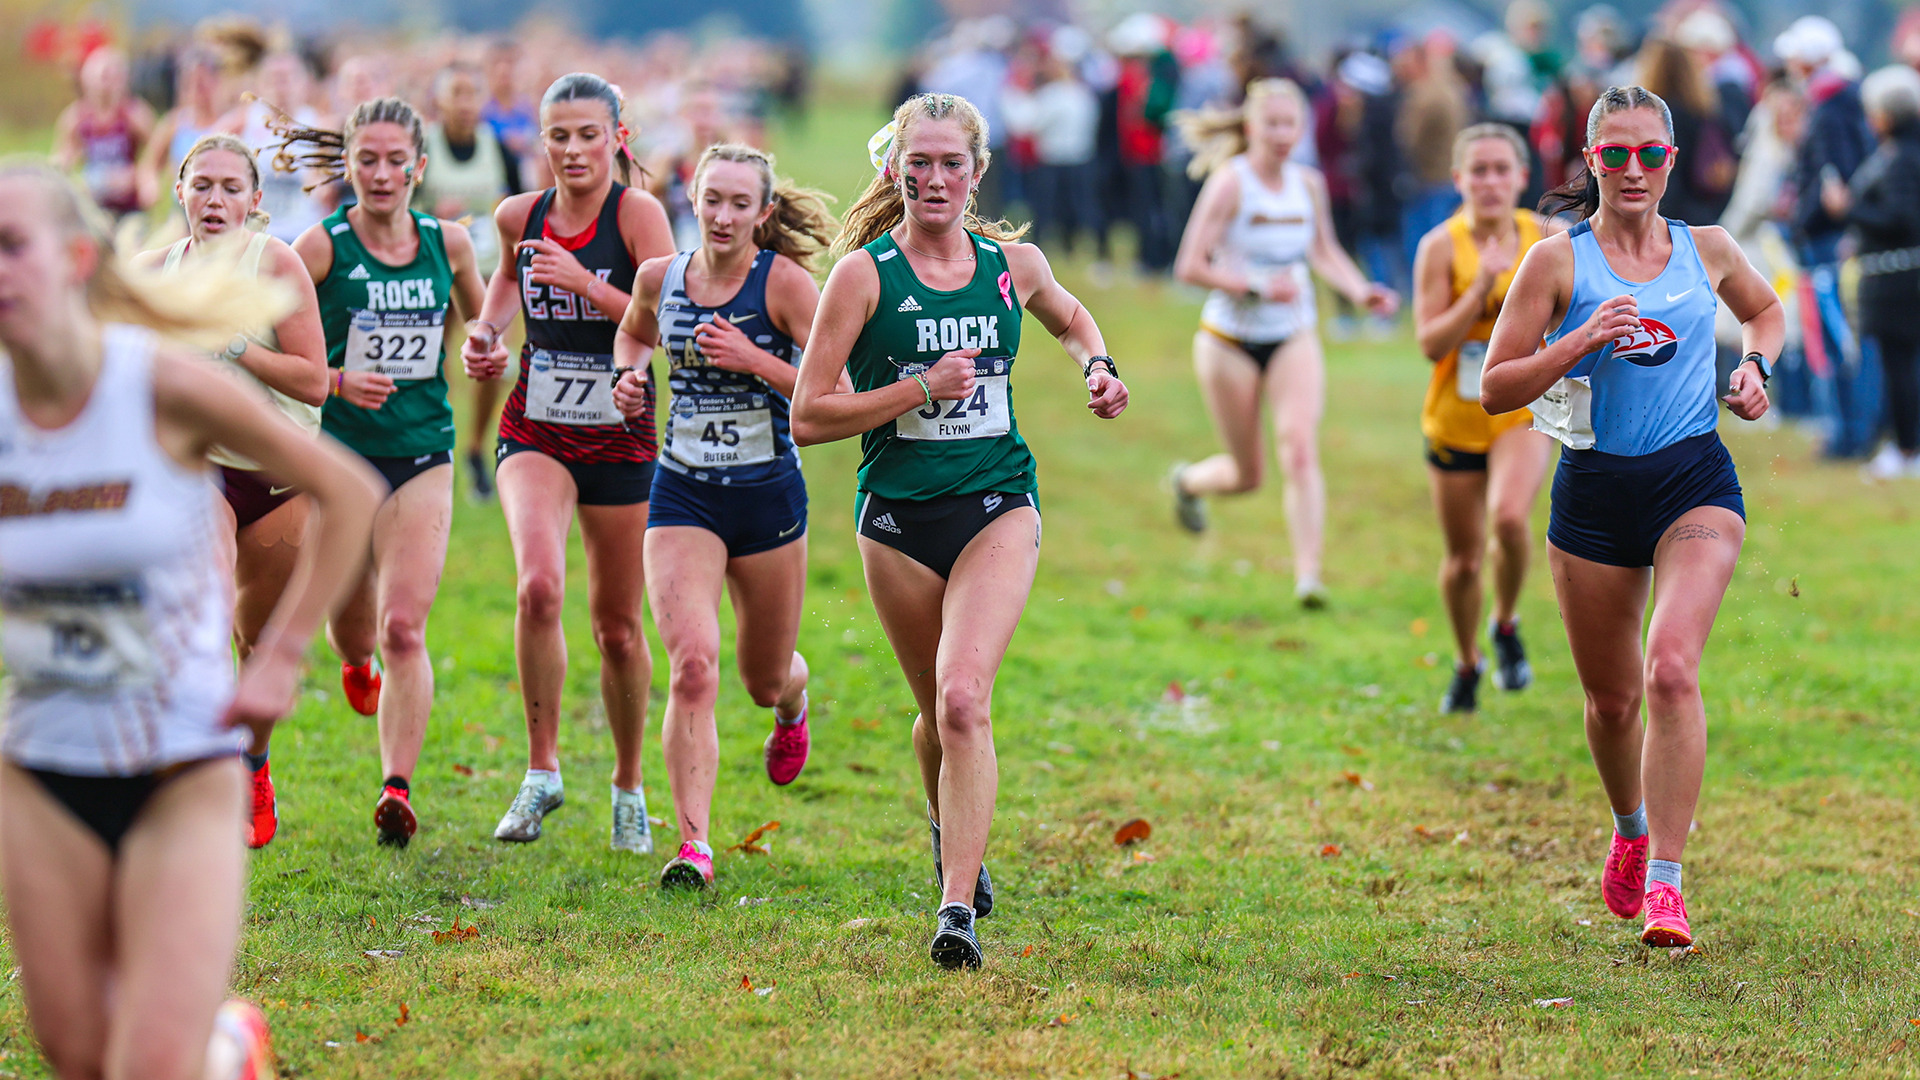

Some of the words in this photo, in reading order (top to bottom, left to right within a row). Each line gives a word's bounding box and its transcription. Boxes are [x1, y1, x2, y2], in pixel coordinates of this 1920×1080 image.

[905, 175, 919, 201] S
[366, 278, 437, 310] ROCK
[915, 315, 1000, 352] ROCK
[364, 335, 427, 361] 322
[556, 361, 580, 369] October
[553, 376, 597, 405] 77
[545, 407, 602, 420] TRENTOWSKI
[700, 419, 740, 447] 45
[939, 424, 971, 435] FLYNN
[703, 452, 739, 461] BUTERA
[872, 518, 902, 535] adidas
